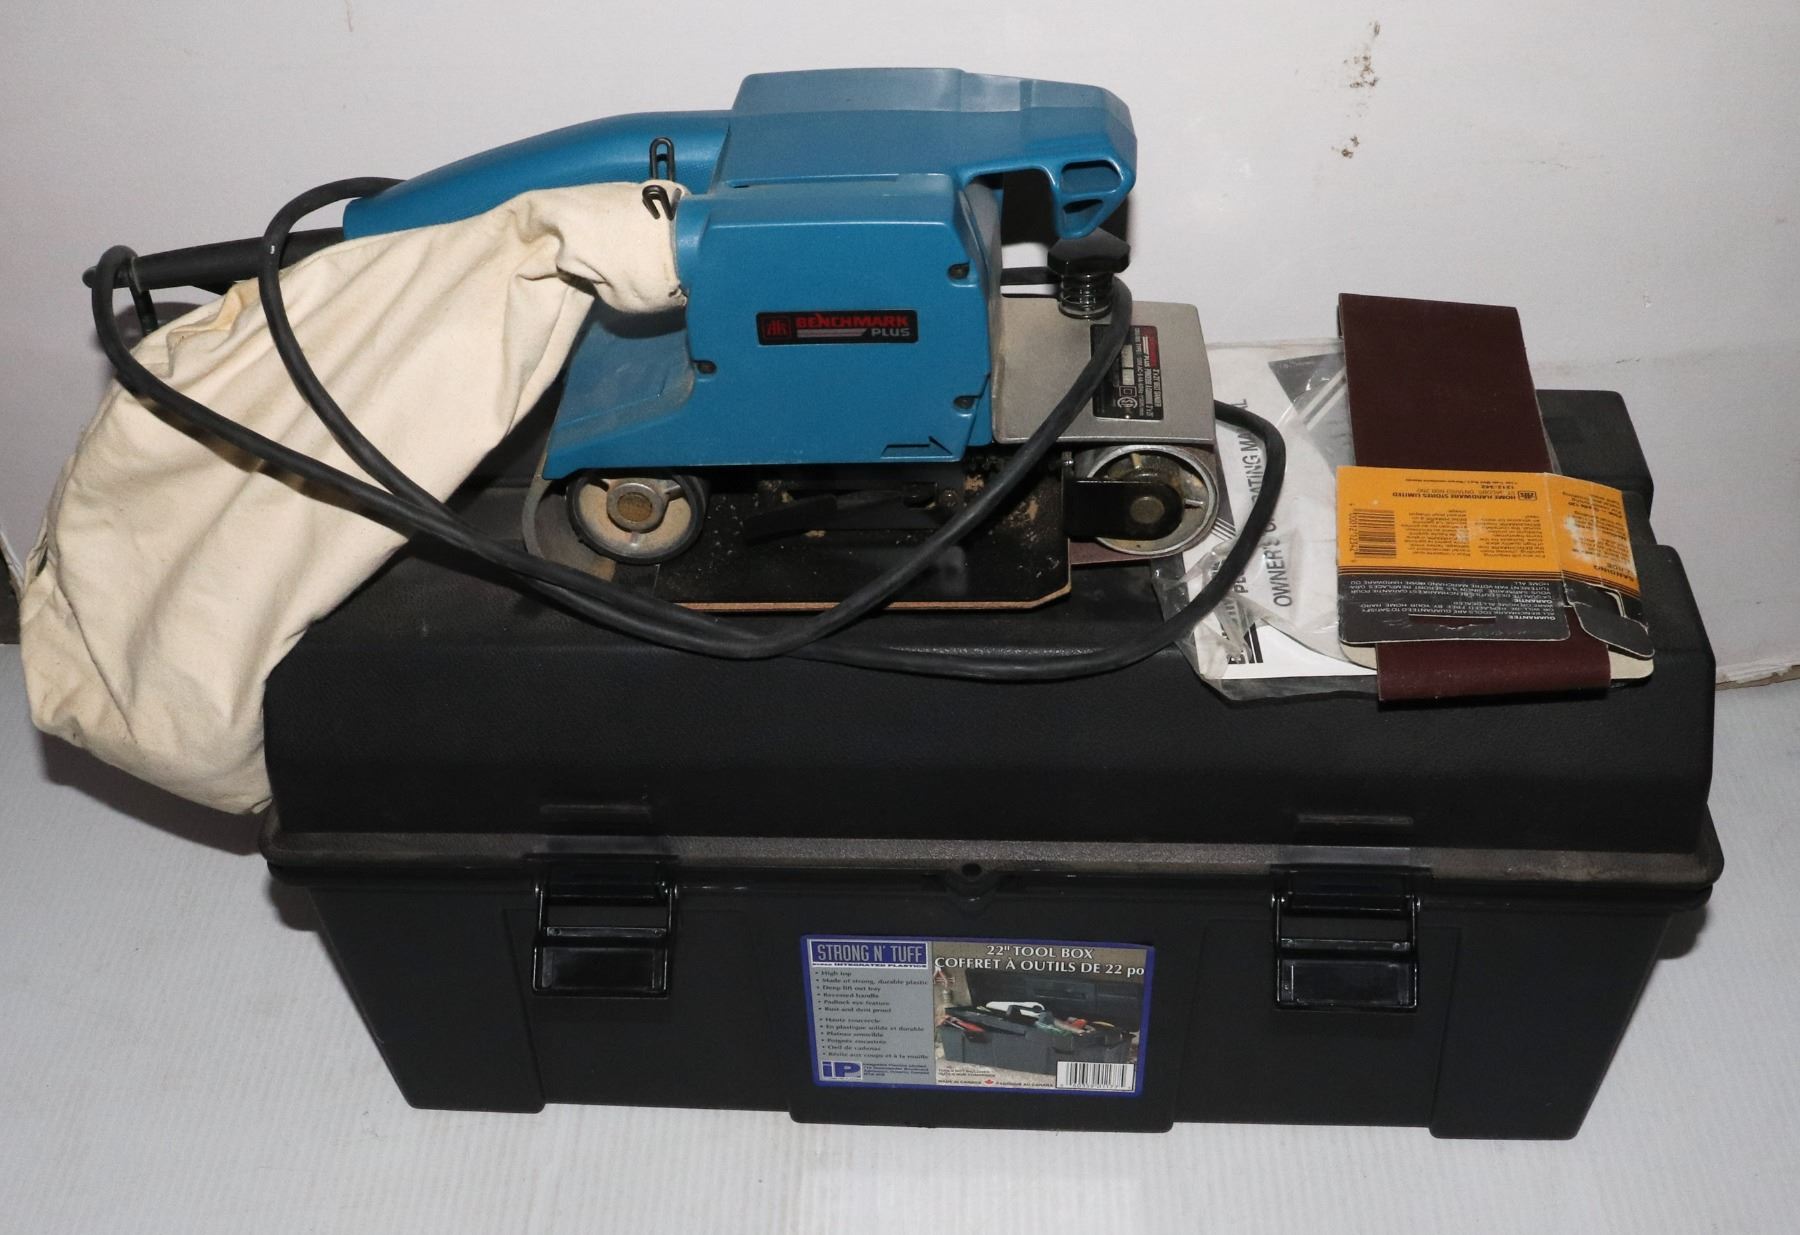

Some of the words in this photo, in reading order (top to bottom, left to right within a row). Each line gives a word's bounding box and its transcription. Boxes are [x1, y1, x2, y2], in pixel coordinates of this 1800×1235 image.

[795, 314, 909, 328] BENCHMARK
[871, 328, 911, 336] PLUS
[817, 944, 869, 962] STRONG
[874, 945, 885, 962] N'
[890, 946, 923, 963] TUFF
[986, 945, 1010, 956] 22"
[1014, 947, 1056, 958] TOOL
[1062, 948, 1094, 960] BOX
[935, 958, 1001, 970] COFFRET
[1006, 957, 1016, 970] À
[1020, 960, 1076, 972] OUTILS
[1081, 963, 1101, 974] DE
[1105, 964, 1123, 974] 22
[1127, 967, 1145, 978] po
